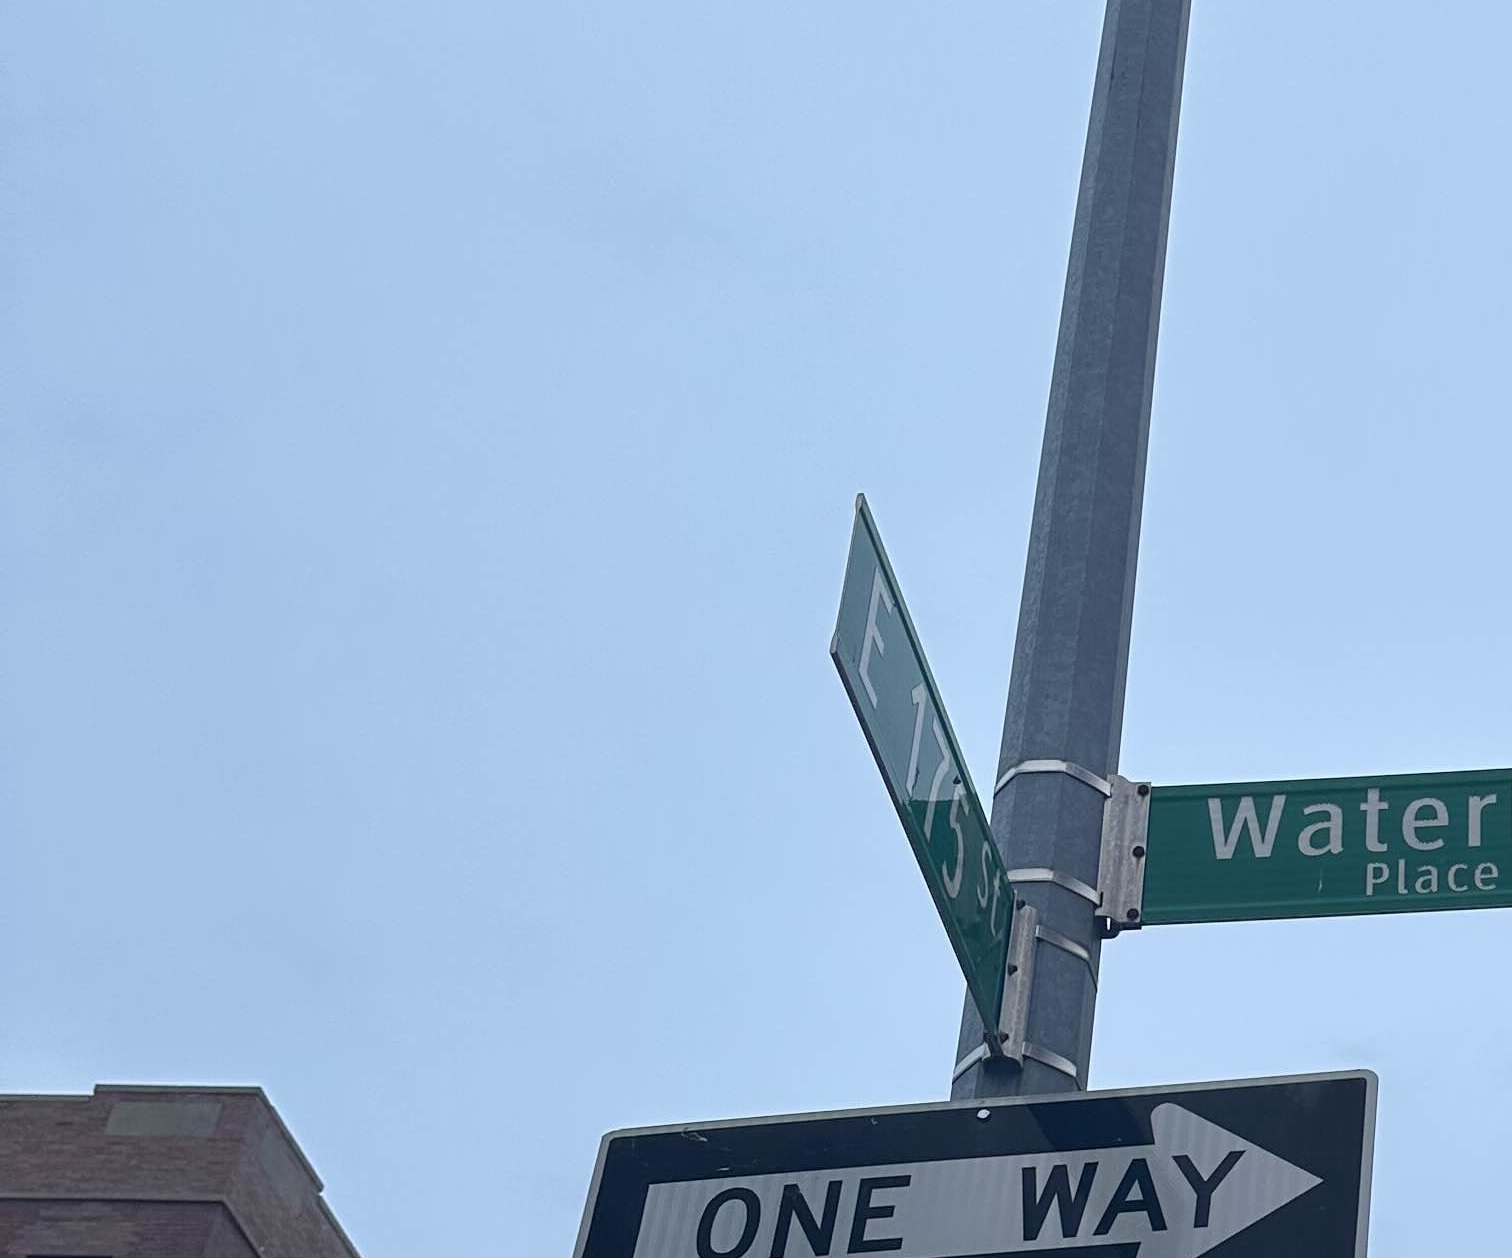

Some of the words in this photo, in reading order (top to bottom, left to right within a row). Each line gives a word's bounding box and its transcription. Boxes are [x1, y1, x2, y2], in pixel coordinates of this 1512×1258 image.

[859, 566, 897, 709] E
[907, 683, 970, 898] 175
[976, 840, 1014, 939] St
[1365, 859, 1500, 896] Place
[1021, 1150, 1247, 1242] WAY
